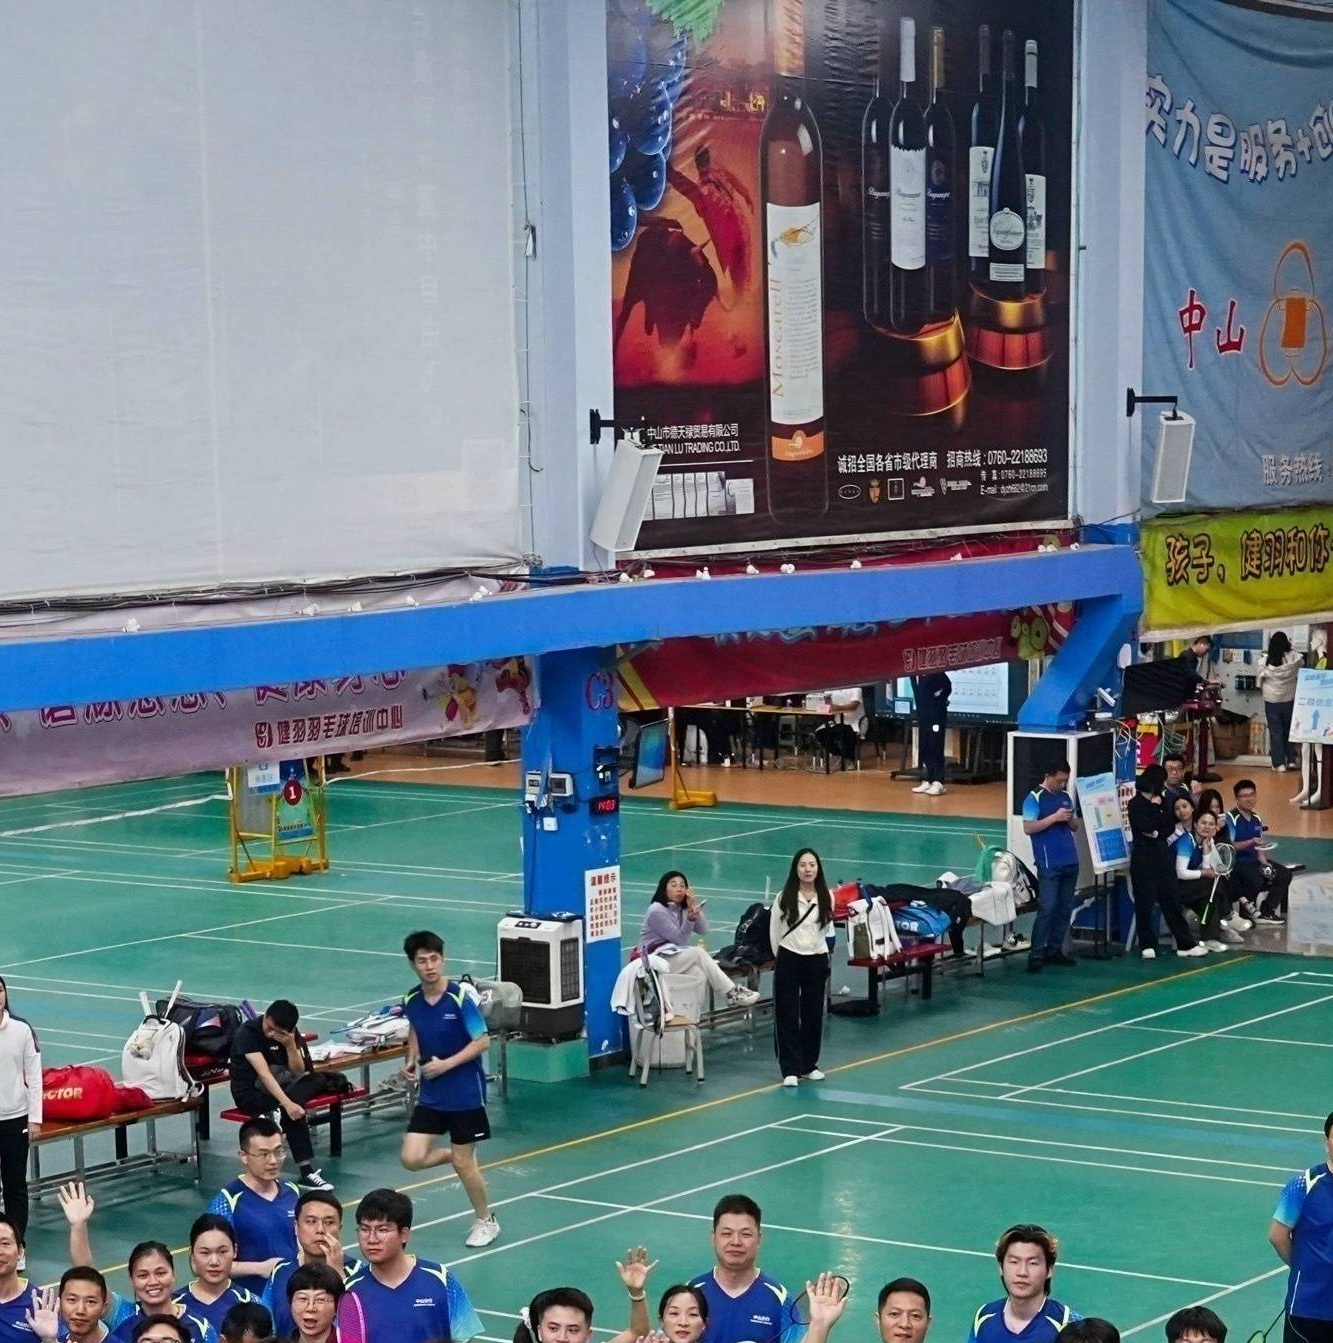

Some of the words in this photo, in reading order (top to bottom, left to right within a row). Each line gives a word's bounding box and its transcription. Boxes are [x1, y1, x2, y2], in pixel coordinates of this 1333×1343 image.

[1177, 288, 1246, 370] 中山
[837, 451, 938, 474] 诚招全国各省市级代理商
[586, 671, 615, 711] C3
[277, 704, 405, 745] 健羽羽毛球培训中心
[289, 786, 297, 799] 1
[43, 1087, 83, 1099] CTOR
